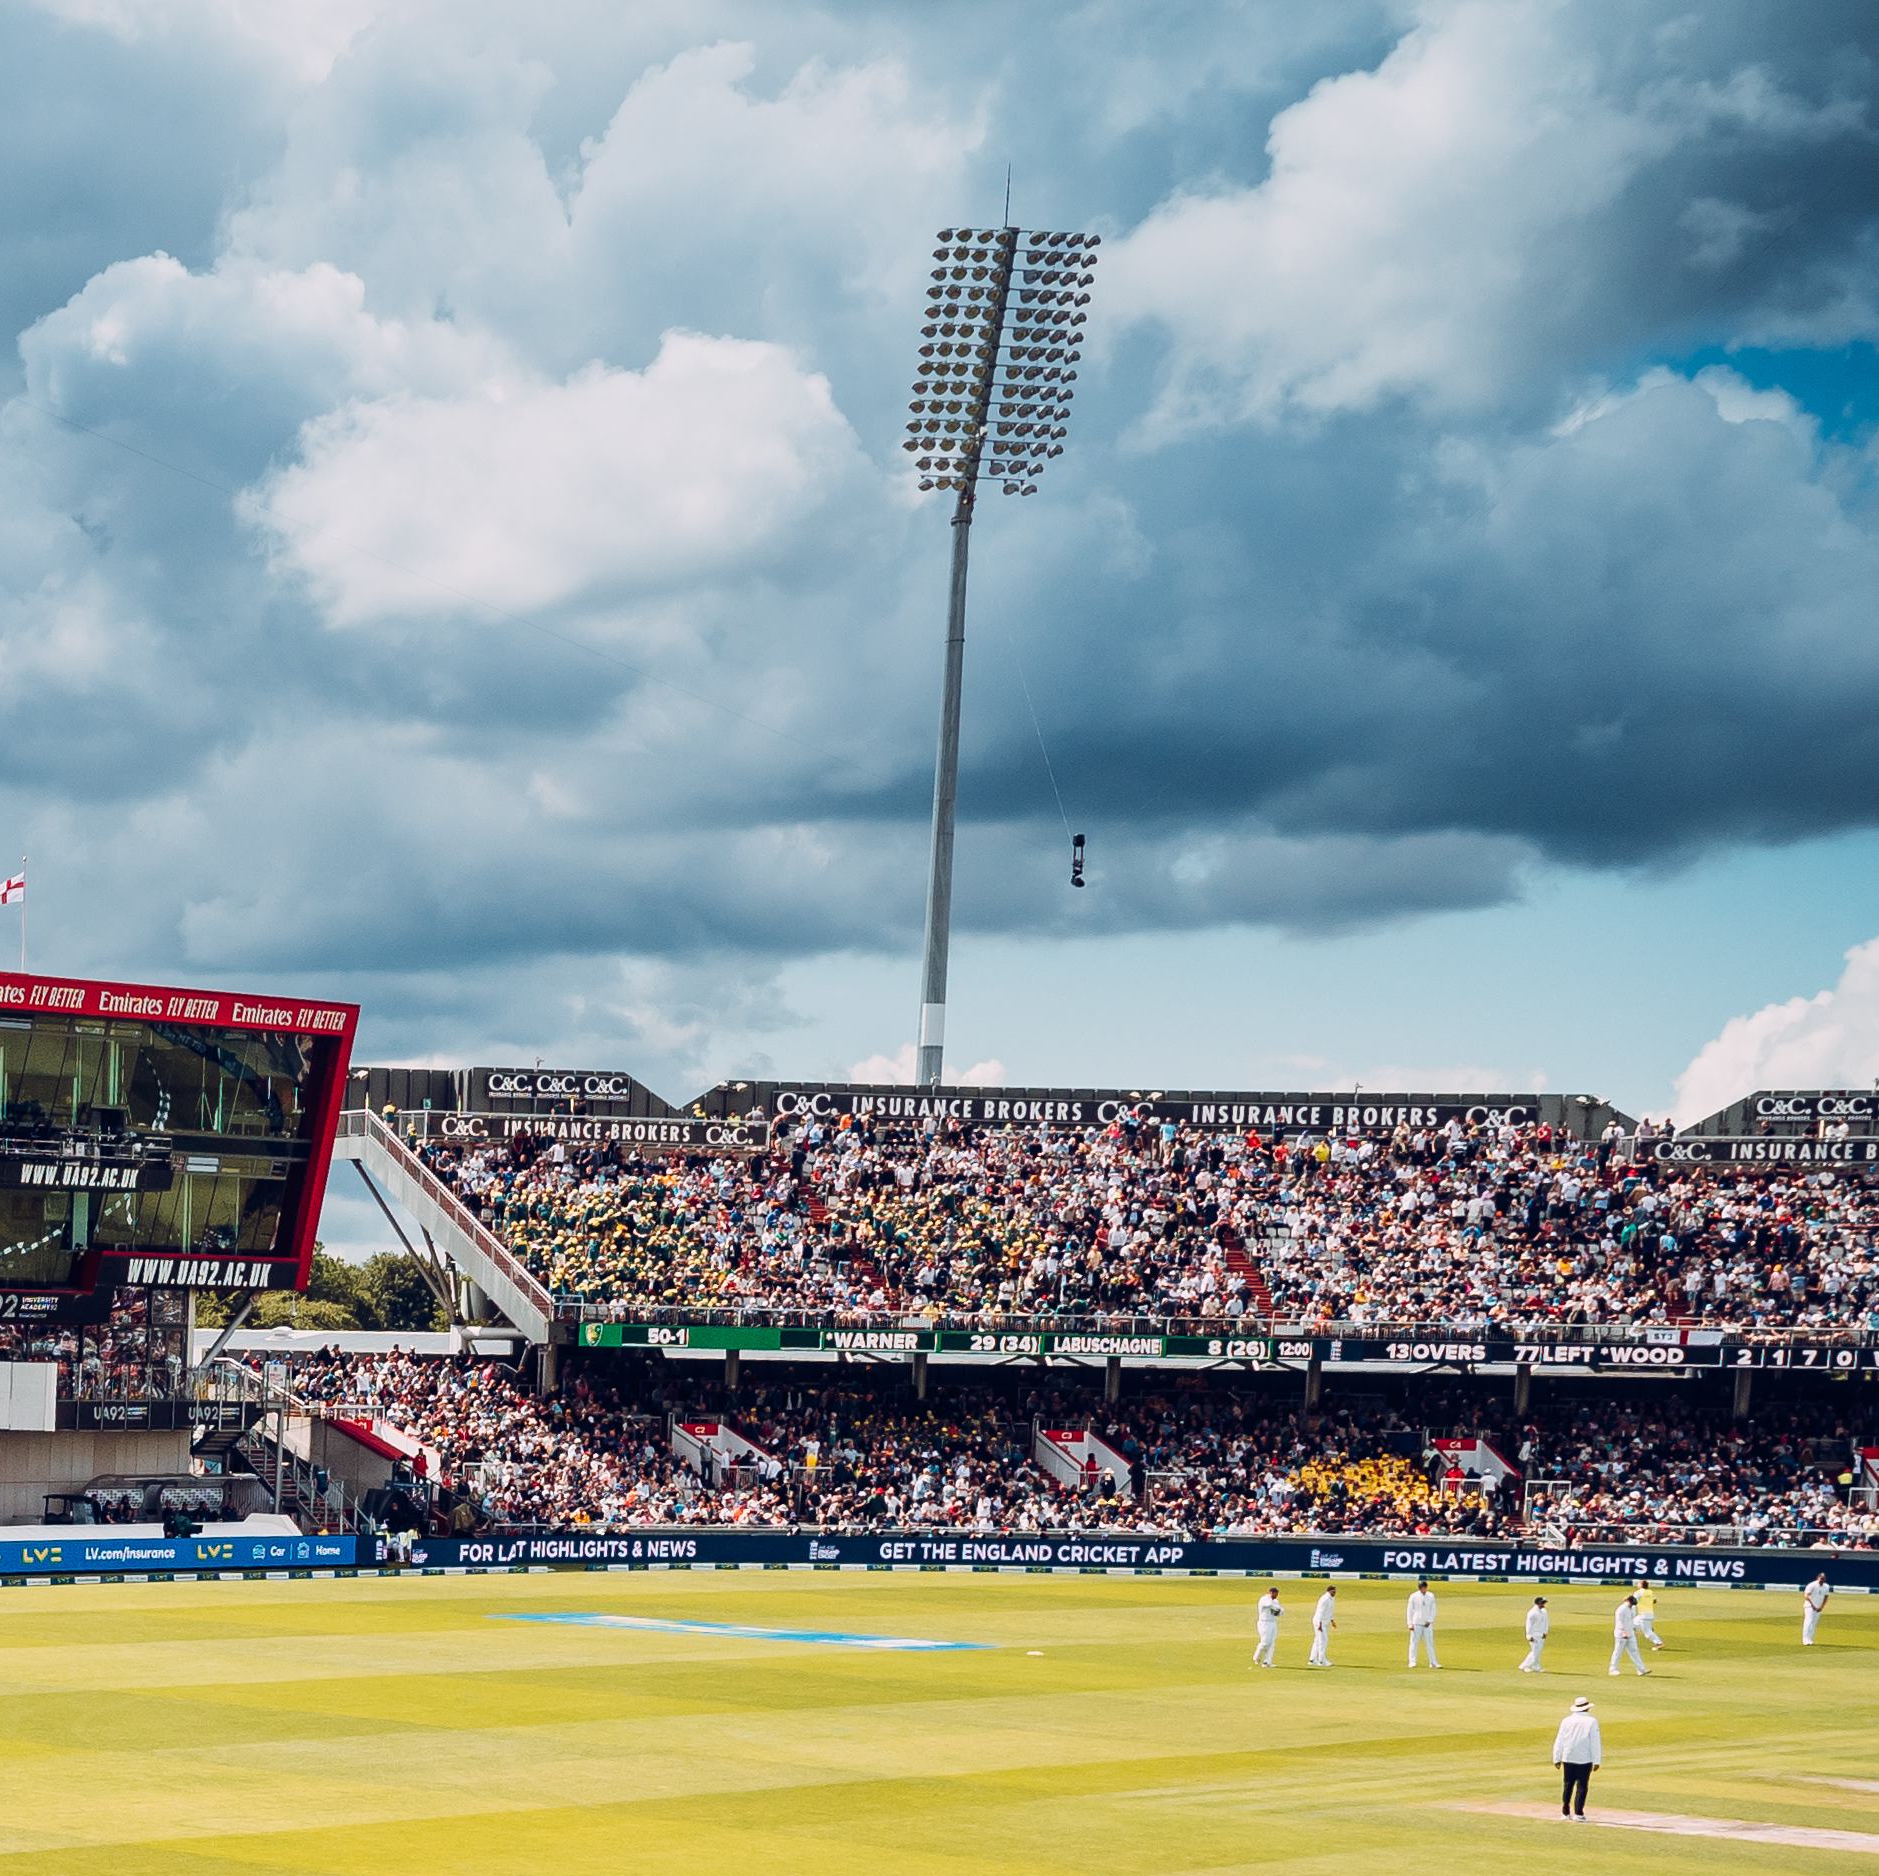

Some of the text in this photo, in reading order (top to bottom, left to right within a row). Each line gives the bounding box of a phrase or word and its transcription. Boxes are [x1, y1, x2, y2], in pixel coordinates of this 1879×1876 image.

[29, 985, 50, 1006] FLY
[48, 986, 86, 1009] BETTER
[488, 1073, 628, 1094] C&C. C&C. C&C.
[776, 1091, 838, 1116] C&C.
[851, 1096, 972, 1119] INSURANCE
[984, 1100, 1082, 1122] BROKERS
[1192, 1104, 1321, 1126] INSURANCE
[1333, 1105, 1438, 1127] BROKERS
[1756, 1097, 1873, 1116] C&C. C&C.
[442, 1117, 754, 1146] C&C. INSURANCE BROKERS C&C.
[1654, 1142, 1712, 1161] C&C.
[1730, 1142, 1854, 1160] INSURANCE
[20, 1163, 140, 1188] WWW.UA92.AC.UK
[126, 1258, 272, 1288] WWW.UA92.AC.UK
[647, 1327, 686, 1345] 50-1
[970, 1335, 996, 1351] 29
[999, 1335, 1038, 1355] (34)
[1053, 1336, 1161, 1355] LABUSCHAGNE
[1208, 1340, 1222, 1356] 8
[1226, 1339, 1266, 1359] (26)
[1278, 1341, 1310, 1357] 12:00
[1386, 1344, 1409, 1360] 13
[1412, 1344, 1486, 1361] OVERS
[1514, 1345, 1539, 1362] 77
[1542, 1345, 1595, 1362] LEFT
[1737, 1349, 1752, 1365] 2
[1772, 1350, 1783, 1365] 1
[1802, 1350, 1817, 1366] 7
[1836, 1350, 1853, 1367] 0
[93, 1405, 125, 1420] UA92
[188, 1405, 219, 1420] UA92
[84, 1546, 176, 1562] LV.com/insurance
[270, 1546, 286, 1558] Car
[315, 1545, 341, 1557] Home
[459, 1540, 697, 1562] FOR HIGHLIGHTS & NEWS
[879, 1542, 1184, 1563] GET THE ENGLAND CRICKET APP
[1383, 1551, 1745, 1578] FOR LATEST HIGHLIGHTS & NEWS
